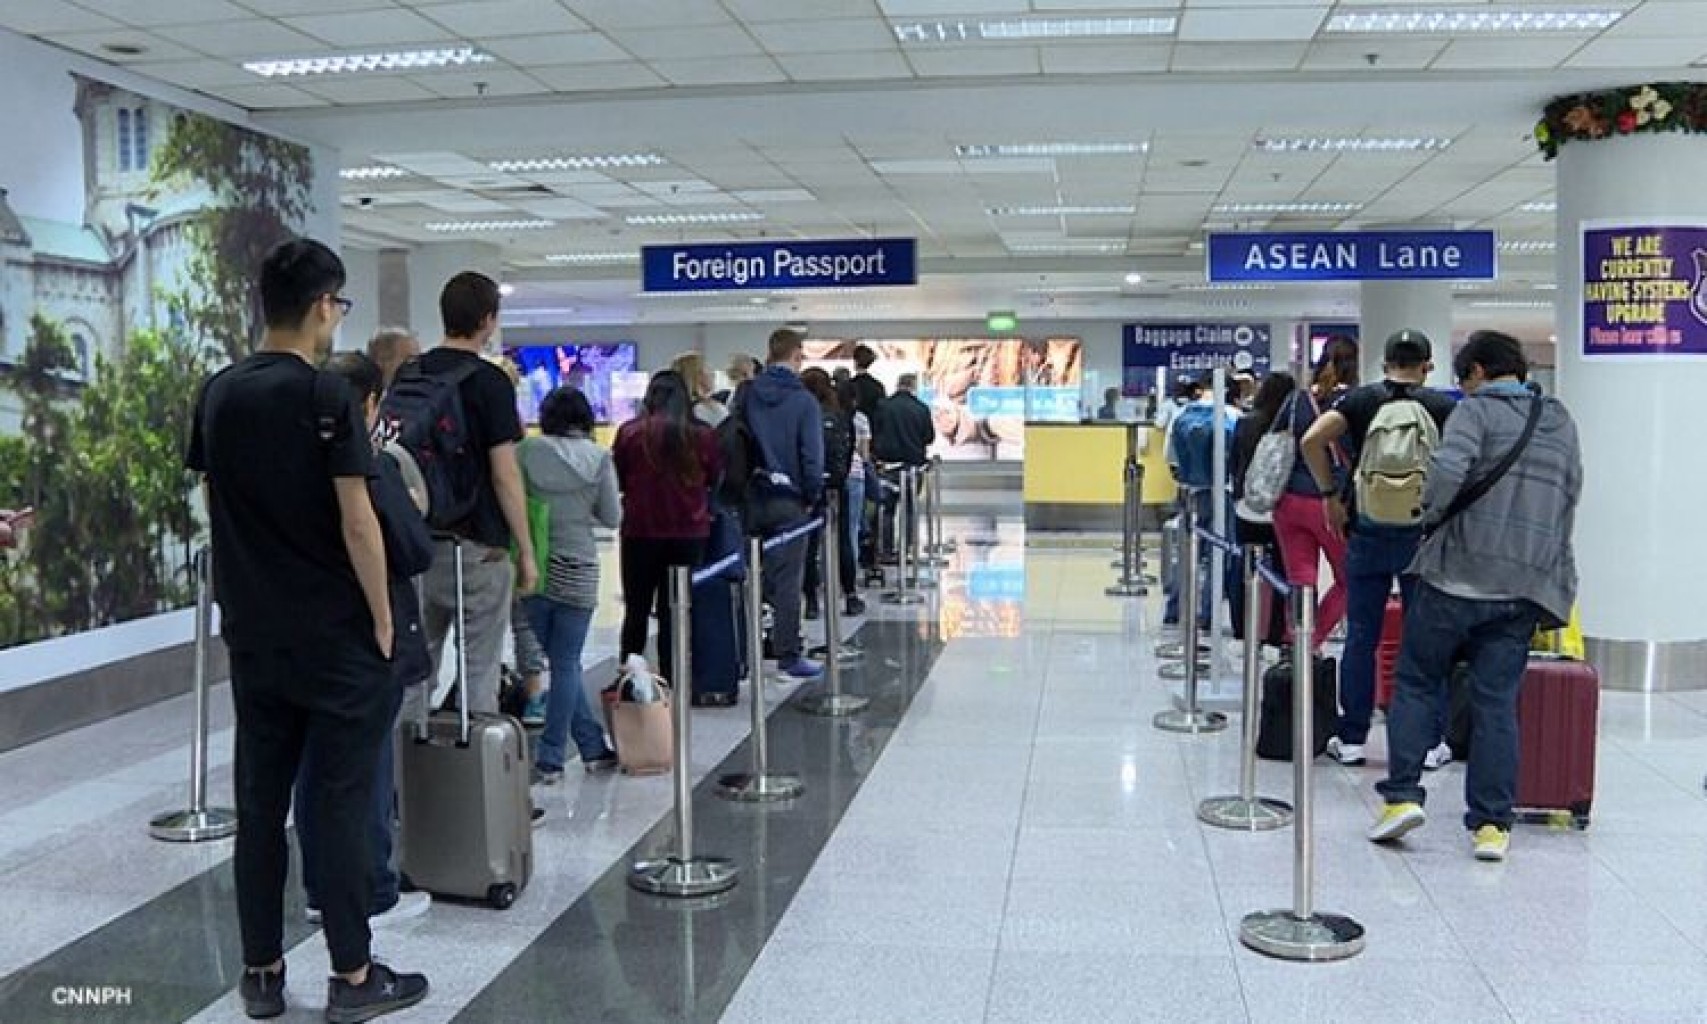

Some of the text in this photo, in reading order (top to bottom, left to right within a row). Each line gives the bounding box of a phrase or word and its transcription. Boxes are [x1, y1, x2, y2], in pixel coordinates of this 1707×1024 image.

[673, 248, 886, 284] Foreign Passport
[1244, 243, 1461, 269] ASEAN Lane
[1135, 325, 1232, 347] Baggage Claim
